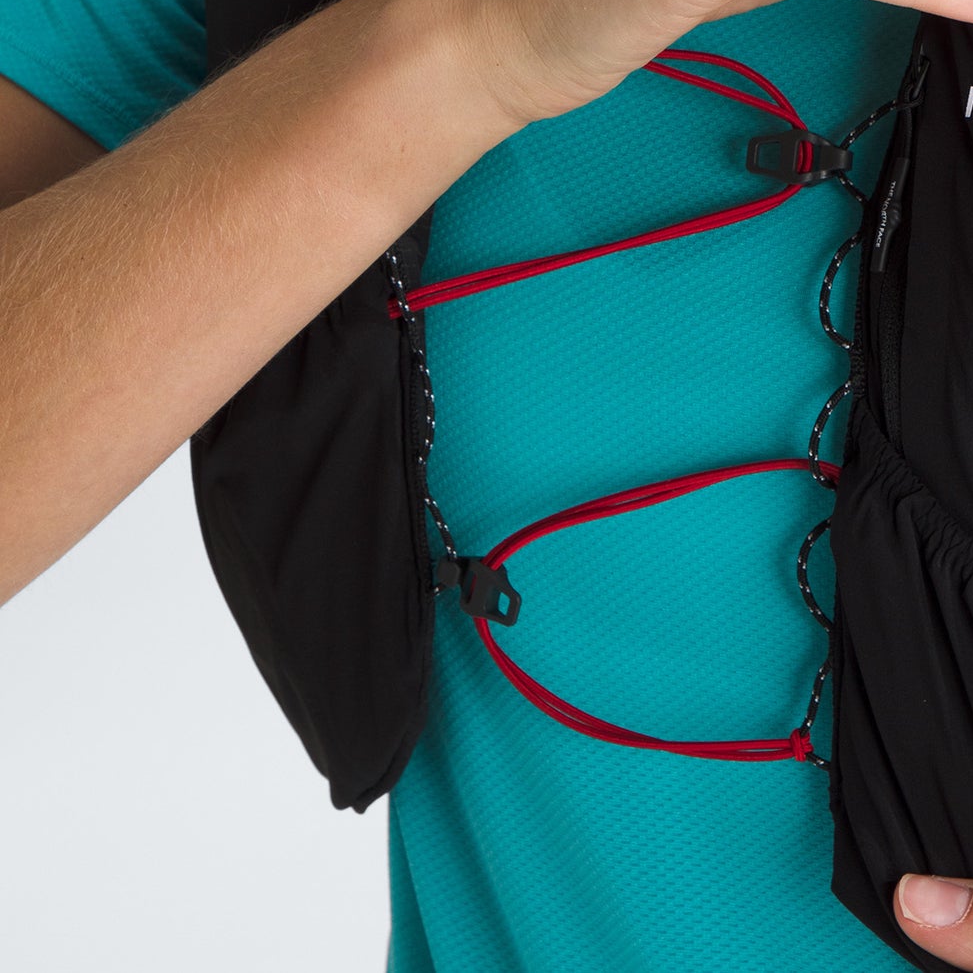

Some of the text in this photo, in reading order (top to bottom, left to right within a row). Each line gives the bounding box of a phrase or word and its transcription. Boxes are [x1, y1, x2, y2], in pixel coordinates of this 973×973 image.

[875, 181, 897, 248] THE NORTH FACE
